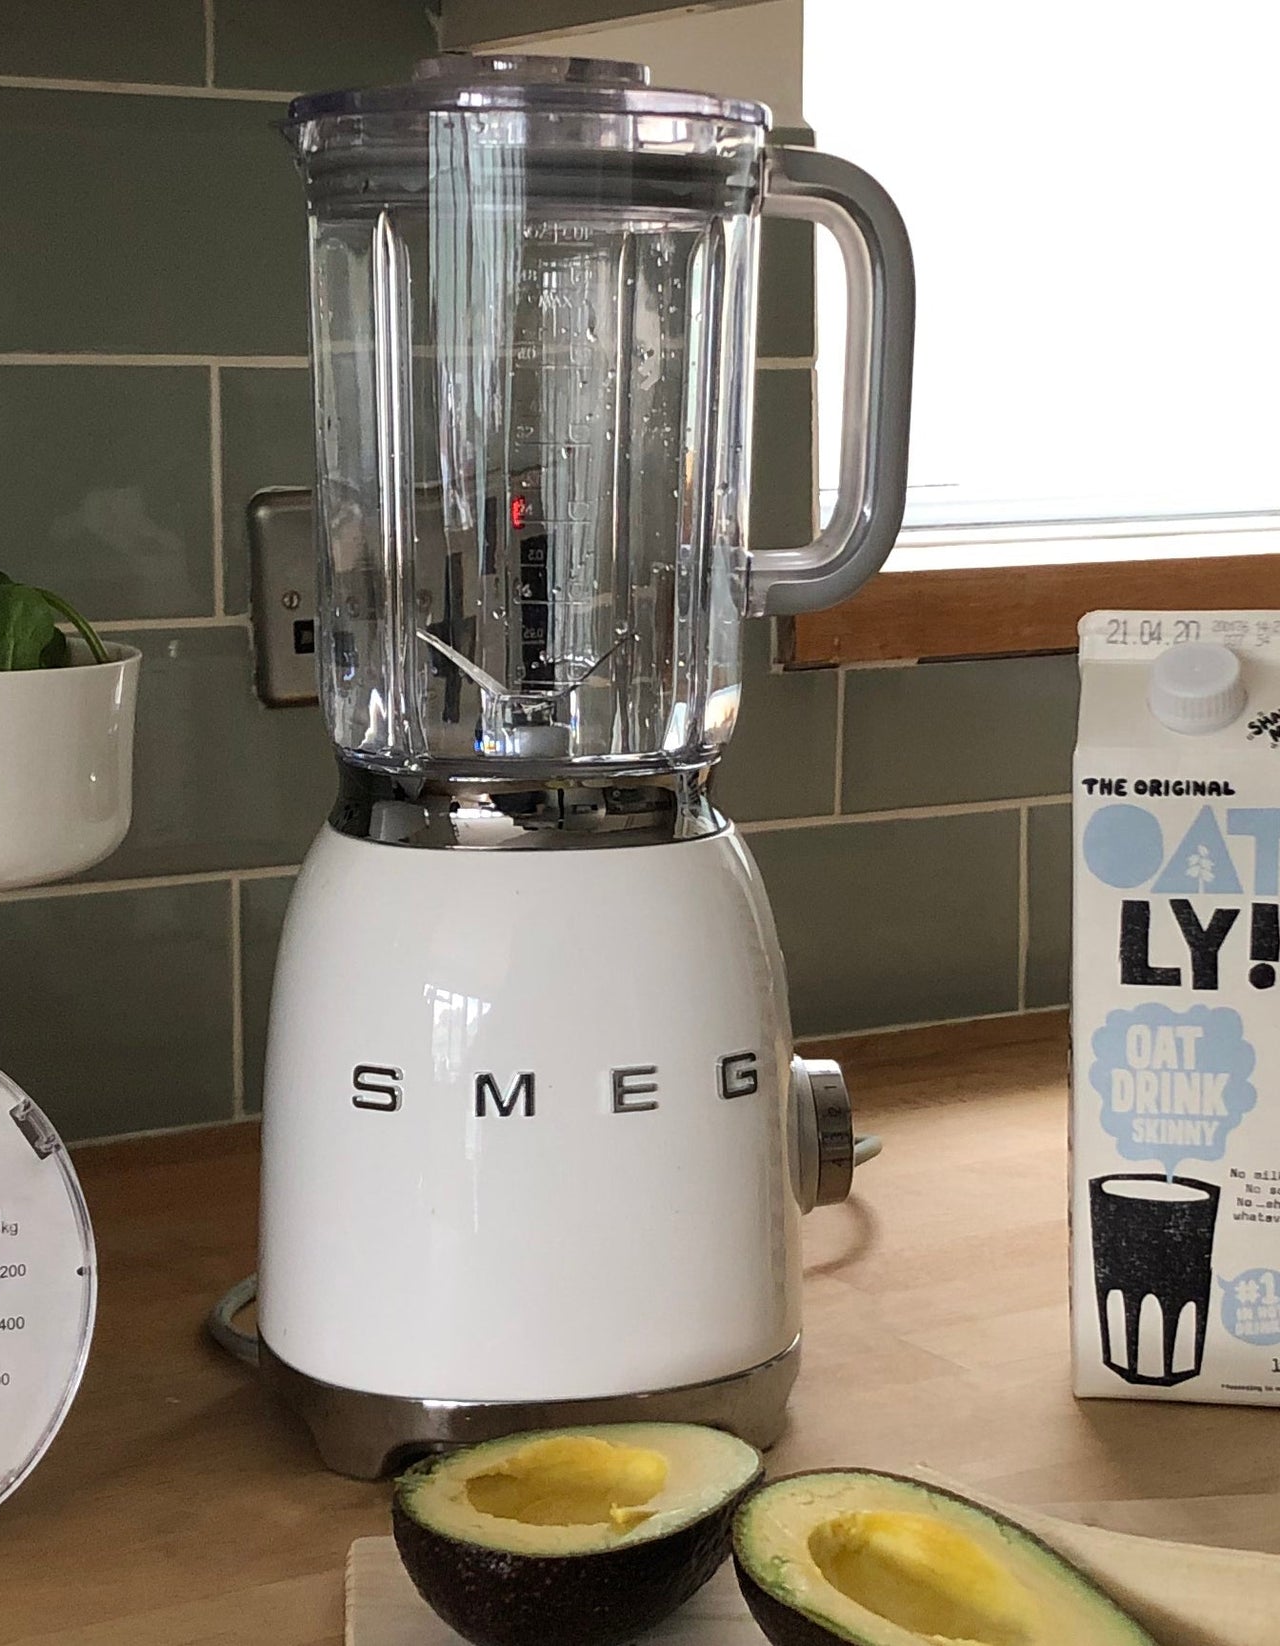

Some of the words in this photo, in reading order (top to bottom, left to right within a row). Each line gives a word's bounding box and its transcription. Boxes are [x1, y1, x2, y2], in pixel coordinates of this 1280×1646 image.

[1081, 778, 1128, 797] THE
[1133, 778, 1236, 797] ORIGINAL
[1119, 898, 1280, 990] LY!
[1125, 1023, 1205, 1071] OAT
[352, 1050, 759, 1118] SMEG
[1111, 1067, 1231, 1117] DRINK
[1131, 1118, 1219, 1147] SKINNY
[1229, 1168, 1246, 1179] No
[1245, 1183, 1261, 1194] No
[1236, 1197, 1252, 1208] No
[0, 1263, 27, 1279] 200
